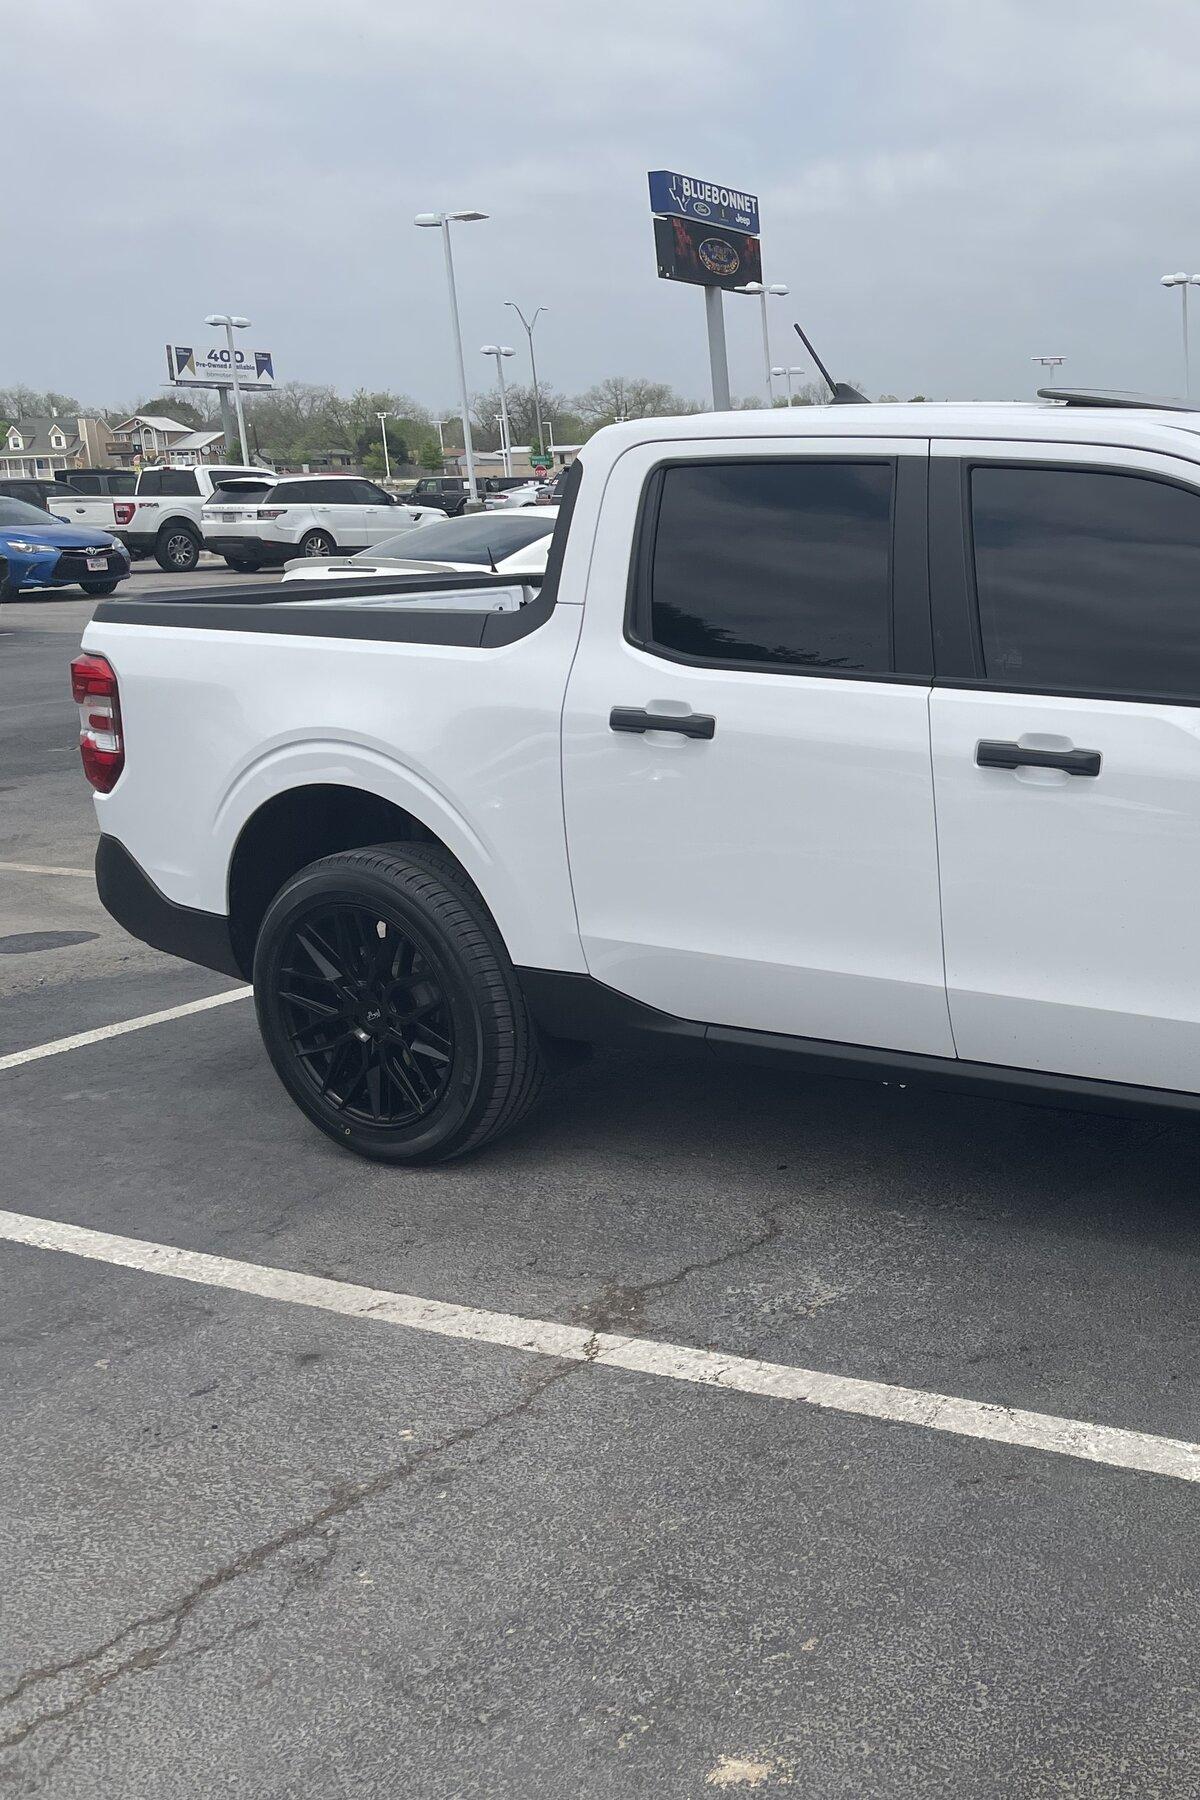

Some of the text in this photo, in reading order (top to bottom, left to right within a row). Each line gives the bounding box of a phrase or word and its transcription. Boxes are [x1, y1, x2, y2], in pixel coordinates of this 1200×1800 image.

[682, 177, 757, 214] BLUEBONNET
[735, 213, 751, 227] Jeep
[207, 348, 245, 363] 400
[196, 361, 228, 369] Pre-Owned
